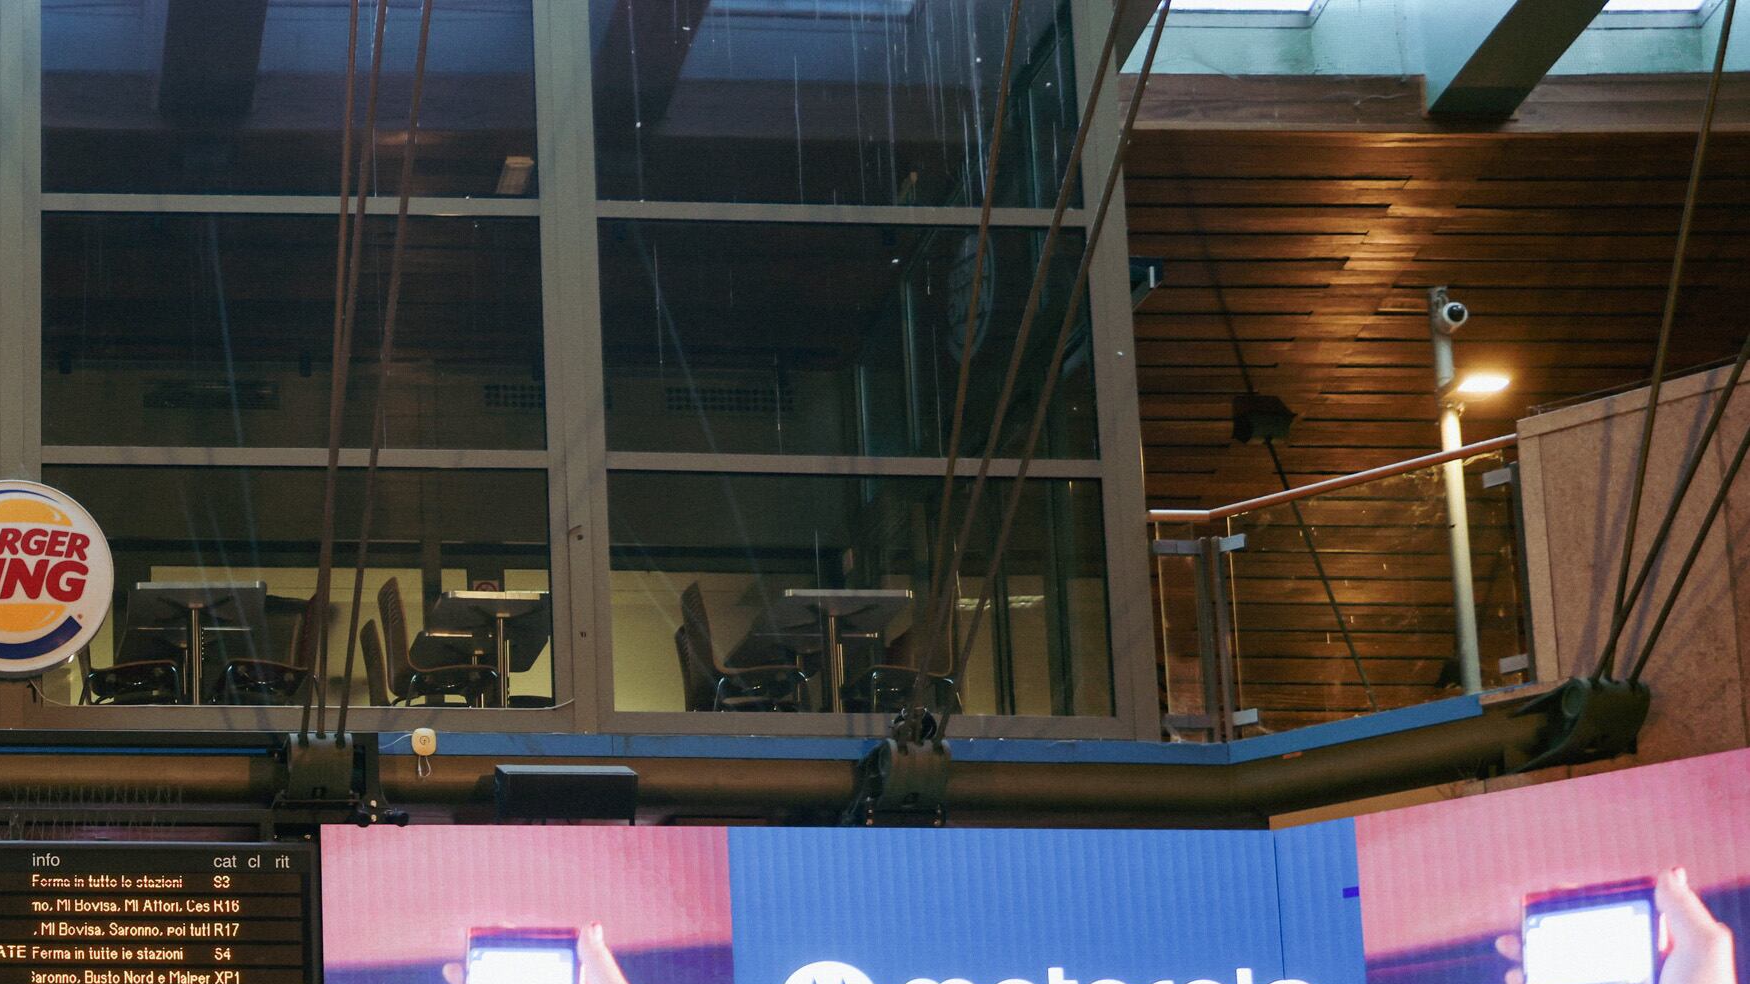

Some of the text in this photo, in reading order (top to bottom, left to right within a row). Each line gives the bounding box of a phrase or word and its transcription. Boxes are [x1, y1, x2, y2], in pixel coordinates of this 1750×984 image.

[32, 853, 60, 867] info
[213, 856, 237, 869] cat
[248, 855, 260, 869] cl
[275, 855, 290, 869] rit
[59, 922, 105, 936] Bovisa,
[109, 922, 163, 936] Saronno,
[167, 923, 186, 936] poi
[214, 923, 240, 936] R17
[214, 947, 231, 960] S4
[85, 970, 120, 984] Busto
[124, 970, 154, 984] Nord
[158, 974, 165, 984] e
[214, 971, 240, 984] XP1
